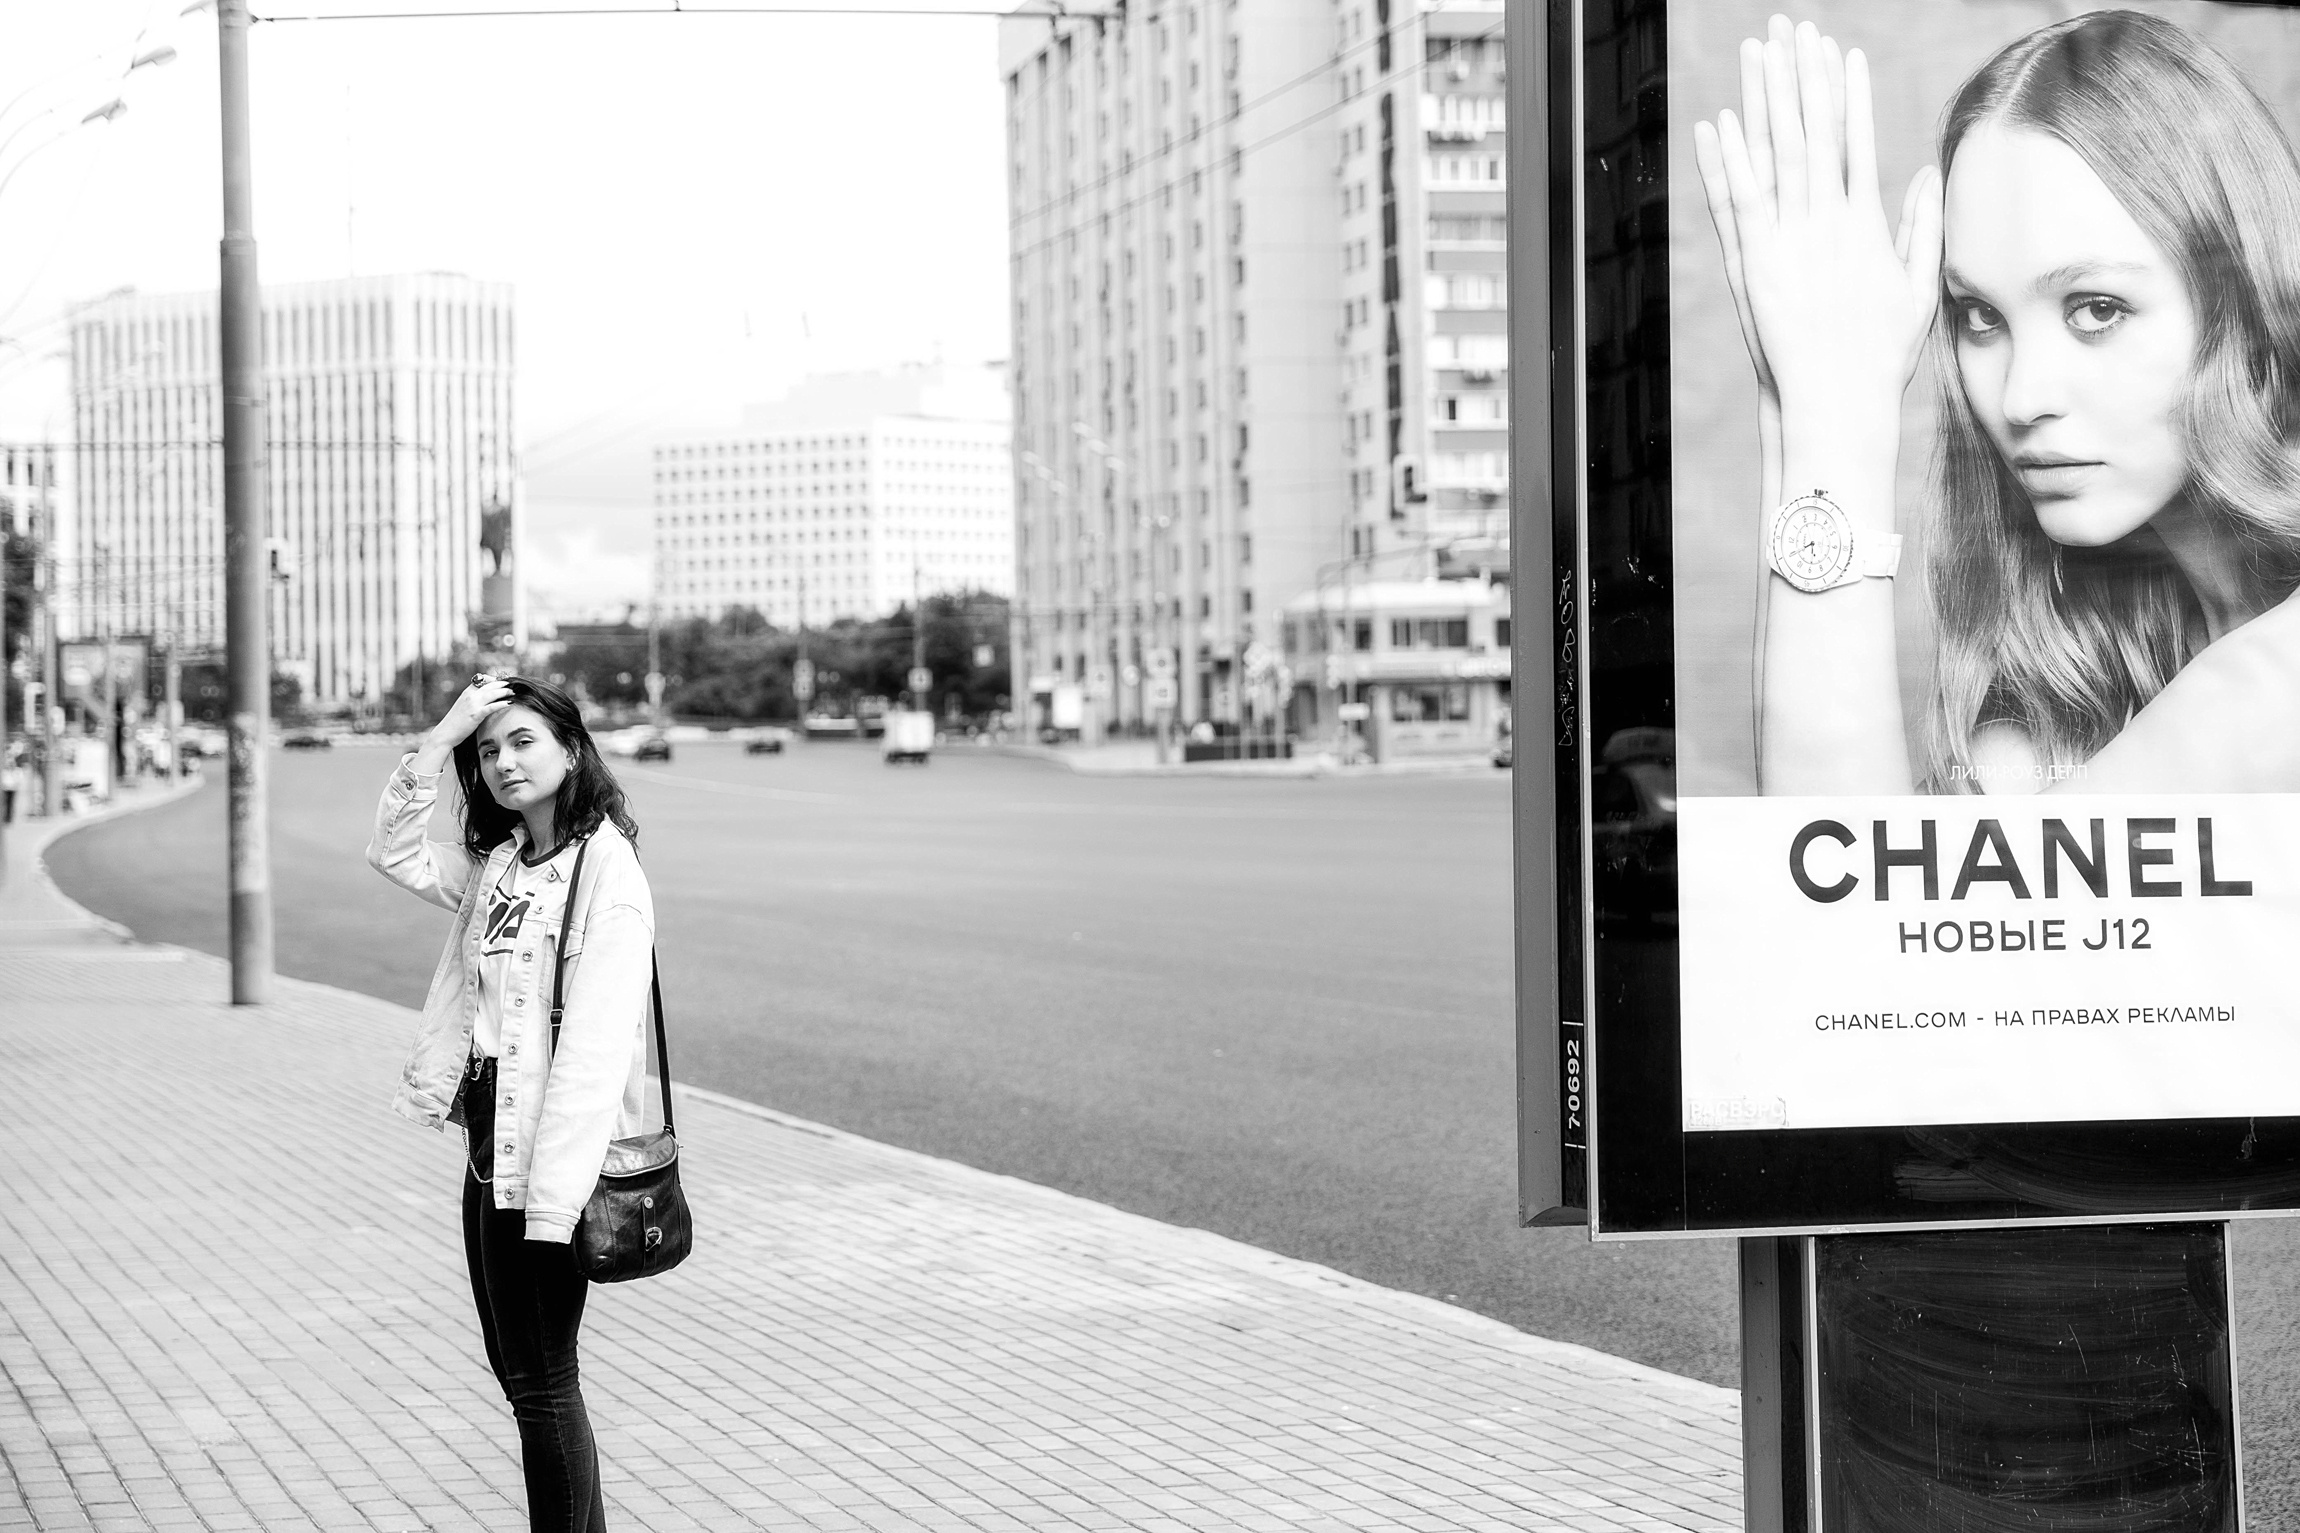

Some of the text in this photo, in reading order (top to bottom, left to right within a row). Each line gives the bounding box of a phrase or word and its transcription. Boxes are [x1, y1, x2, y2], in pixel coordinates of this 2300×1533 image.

[2047, 765, 2088, 781] ДЕПП
[1790, 818, 2253, 904] CHANEL
[1900, 918, 2152, 954] НОВЫЕ J12
[1815, 1011, 1967, 1031] CHANEL.COM
[1995, 1010, 2025, 1027] НА
[2032, 1008, 2120, 1027] ПРАВАХ
[2128, 1005, 2236, 1024] РЕКЛАМЫ
[1567, 1039, 1582, 1130] 70692
